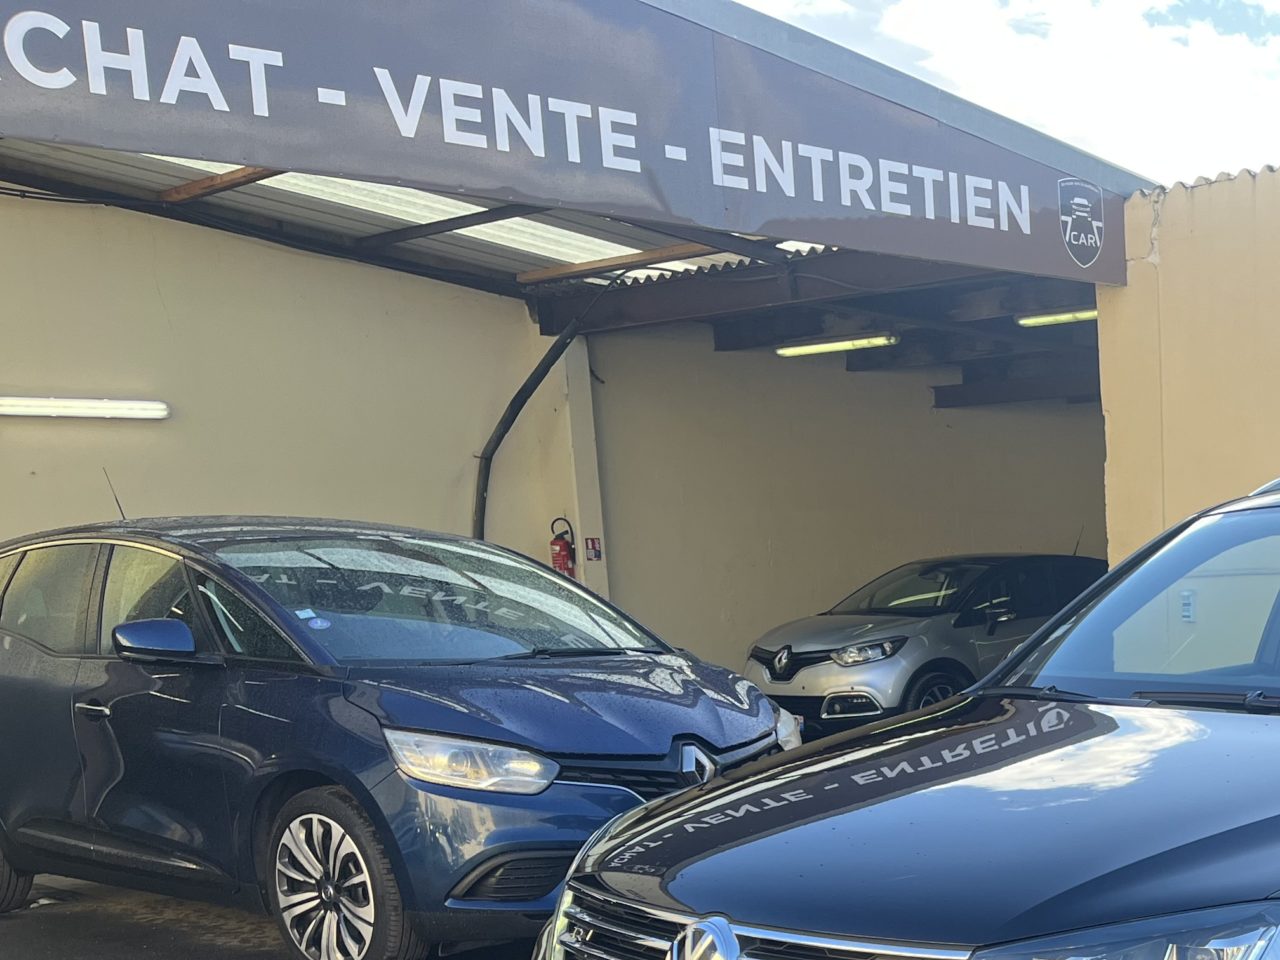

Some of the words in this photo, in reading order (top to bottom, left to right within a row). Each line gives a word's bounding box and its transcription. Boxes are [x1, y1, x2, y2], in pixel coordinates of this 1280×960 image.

[0, 10, 284, 117] CHAT
[373, 66, 642, 173] VENTE
[708, 127, 1032, 235] ENTRETIEN
